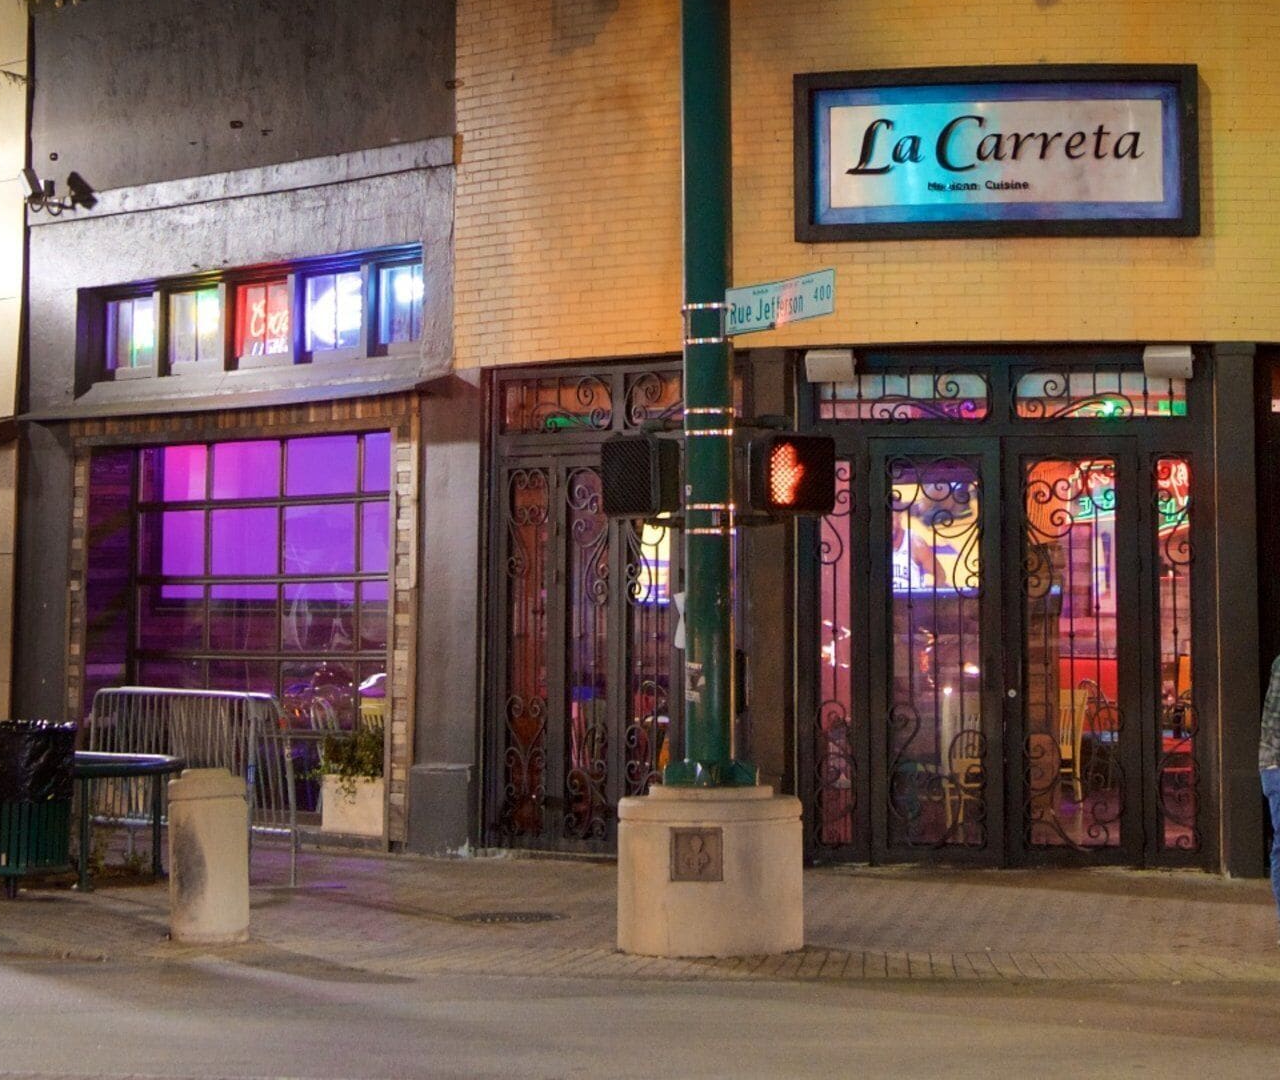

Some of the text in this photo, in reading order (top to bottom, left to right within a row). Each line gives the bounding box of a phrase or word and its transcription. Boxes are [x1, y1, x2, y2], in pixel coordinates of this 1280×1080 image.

[845, 114, 1144, 175] La Carreta
[984, 180, 1030, 190] Cuisine
[730, 302, 752, 326] Rue
[756, 294, 804, 321] Jefferson
[813, 284, 832, 302] 400
